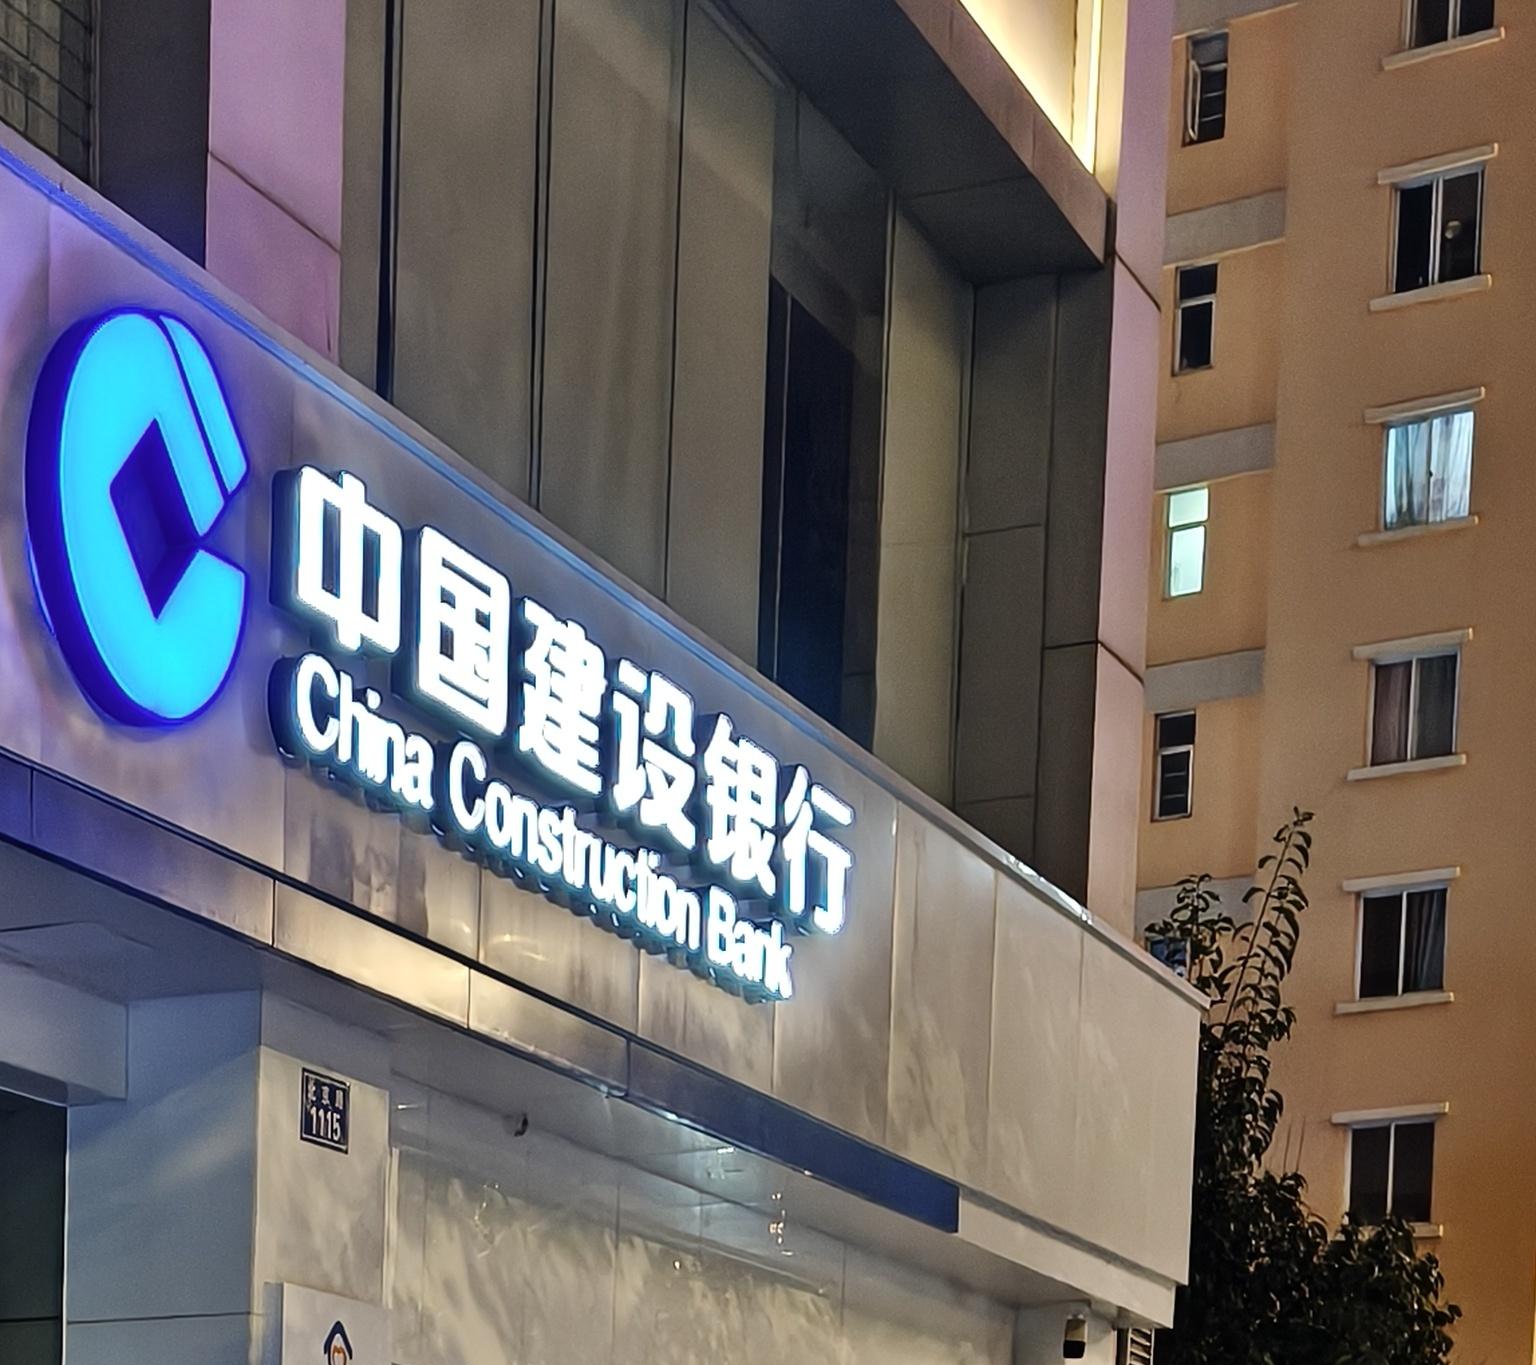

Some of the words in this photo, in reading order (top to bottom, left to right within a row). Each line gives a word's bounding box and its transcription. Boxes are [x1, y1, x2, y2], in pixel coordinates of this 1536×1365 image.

[296, 465, 855, 936] 中国建设银行
[296, 653, 434, 809] China
[448, 741, 700, 951] Construction
[706, 887, 792, 999] Bank
[310, 1106, 341, 1141] 1115
